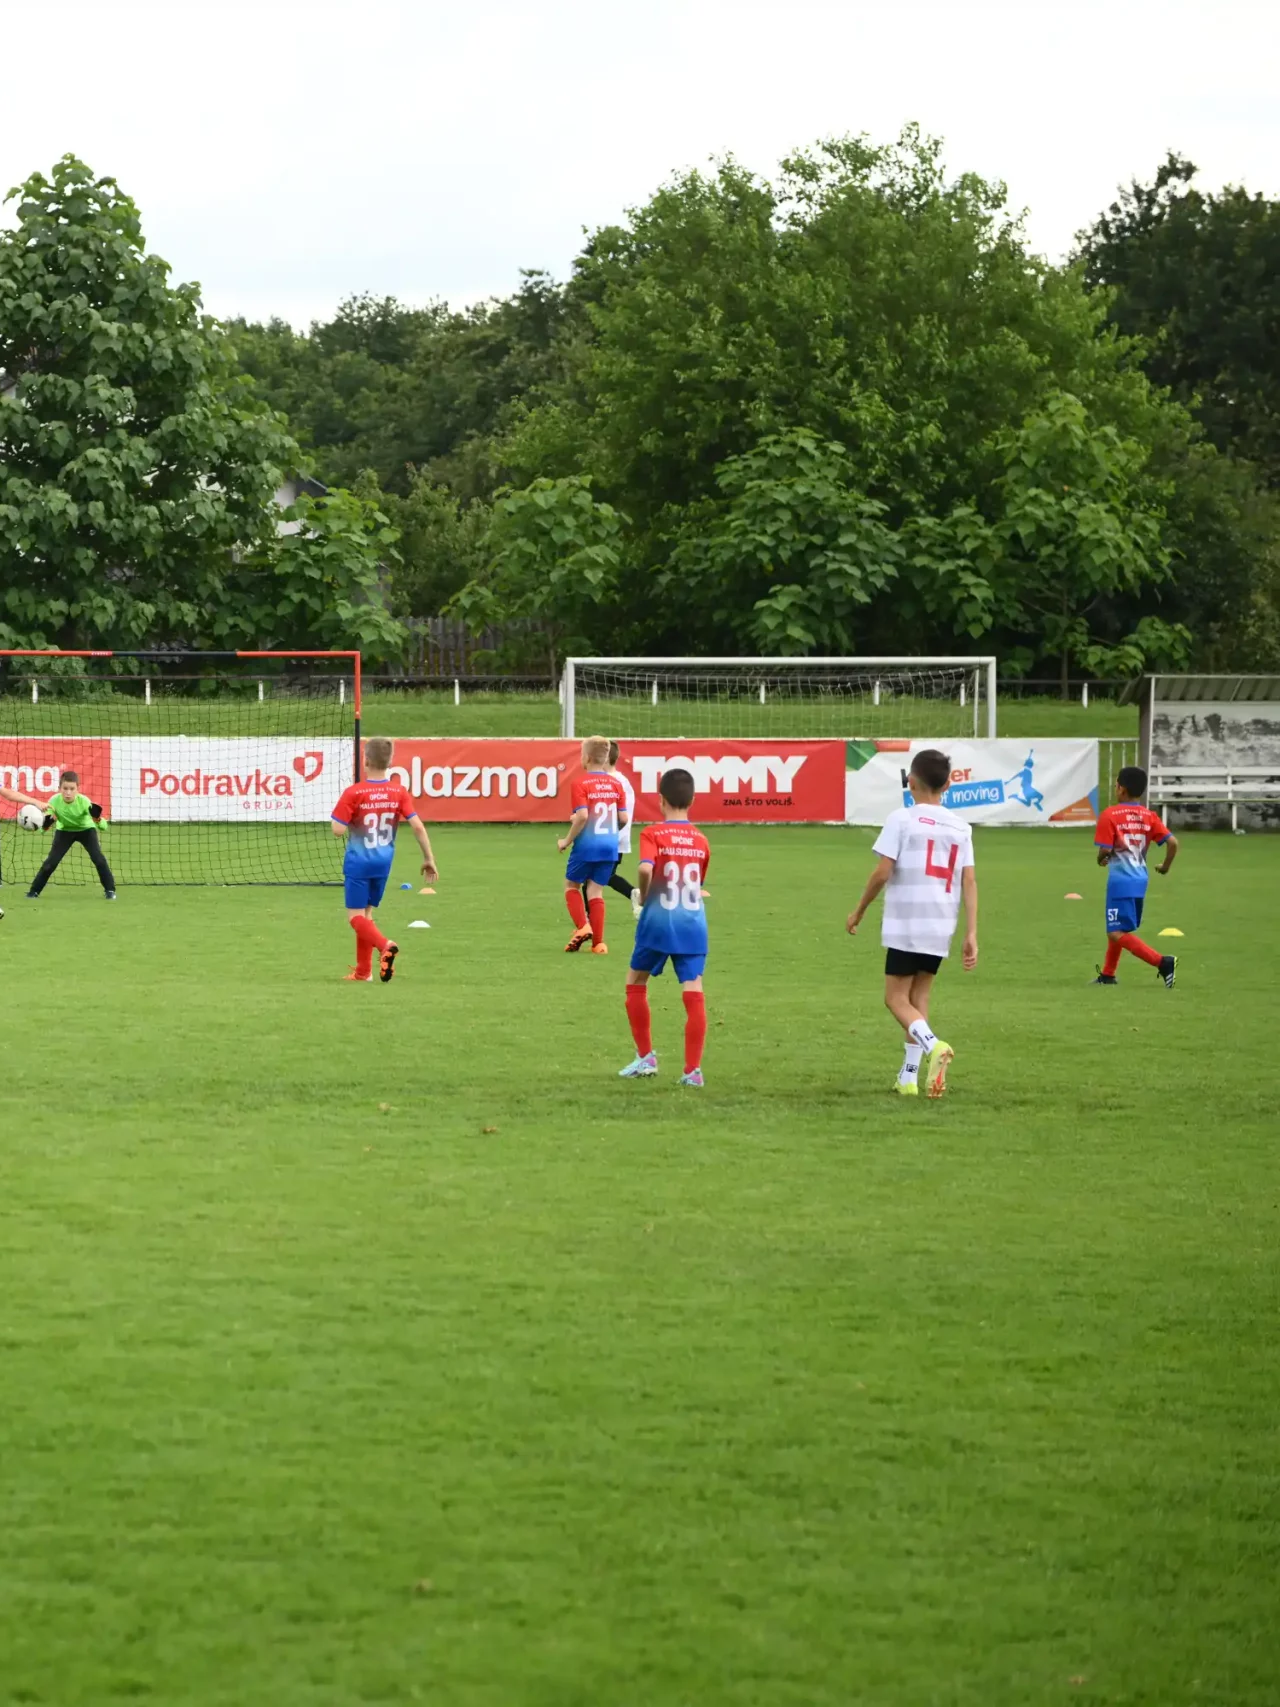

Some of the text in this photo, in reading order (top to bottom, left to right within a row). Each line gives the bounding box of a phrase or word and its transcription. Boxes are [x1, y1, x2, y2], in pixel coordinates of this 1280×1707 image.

[139, 767, 293, 796] Podravka
[952, 786, 999, 804] moving
[243, 801, 293, 810] GRUPA
[744, 796, 762, 806] ŠTO
[363, 812, 395, 849] 35
[594, 802, 618, 835] 21
[925, 838, 959, 893] 4
[660, 860, 702, 911] 38
[1107, 908, 1119, 921] 57
